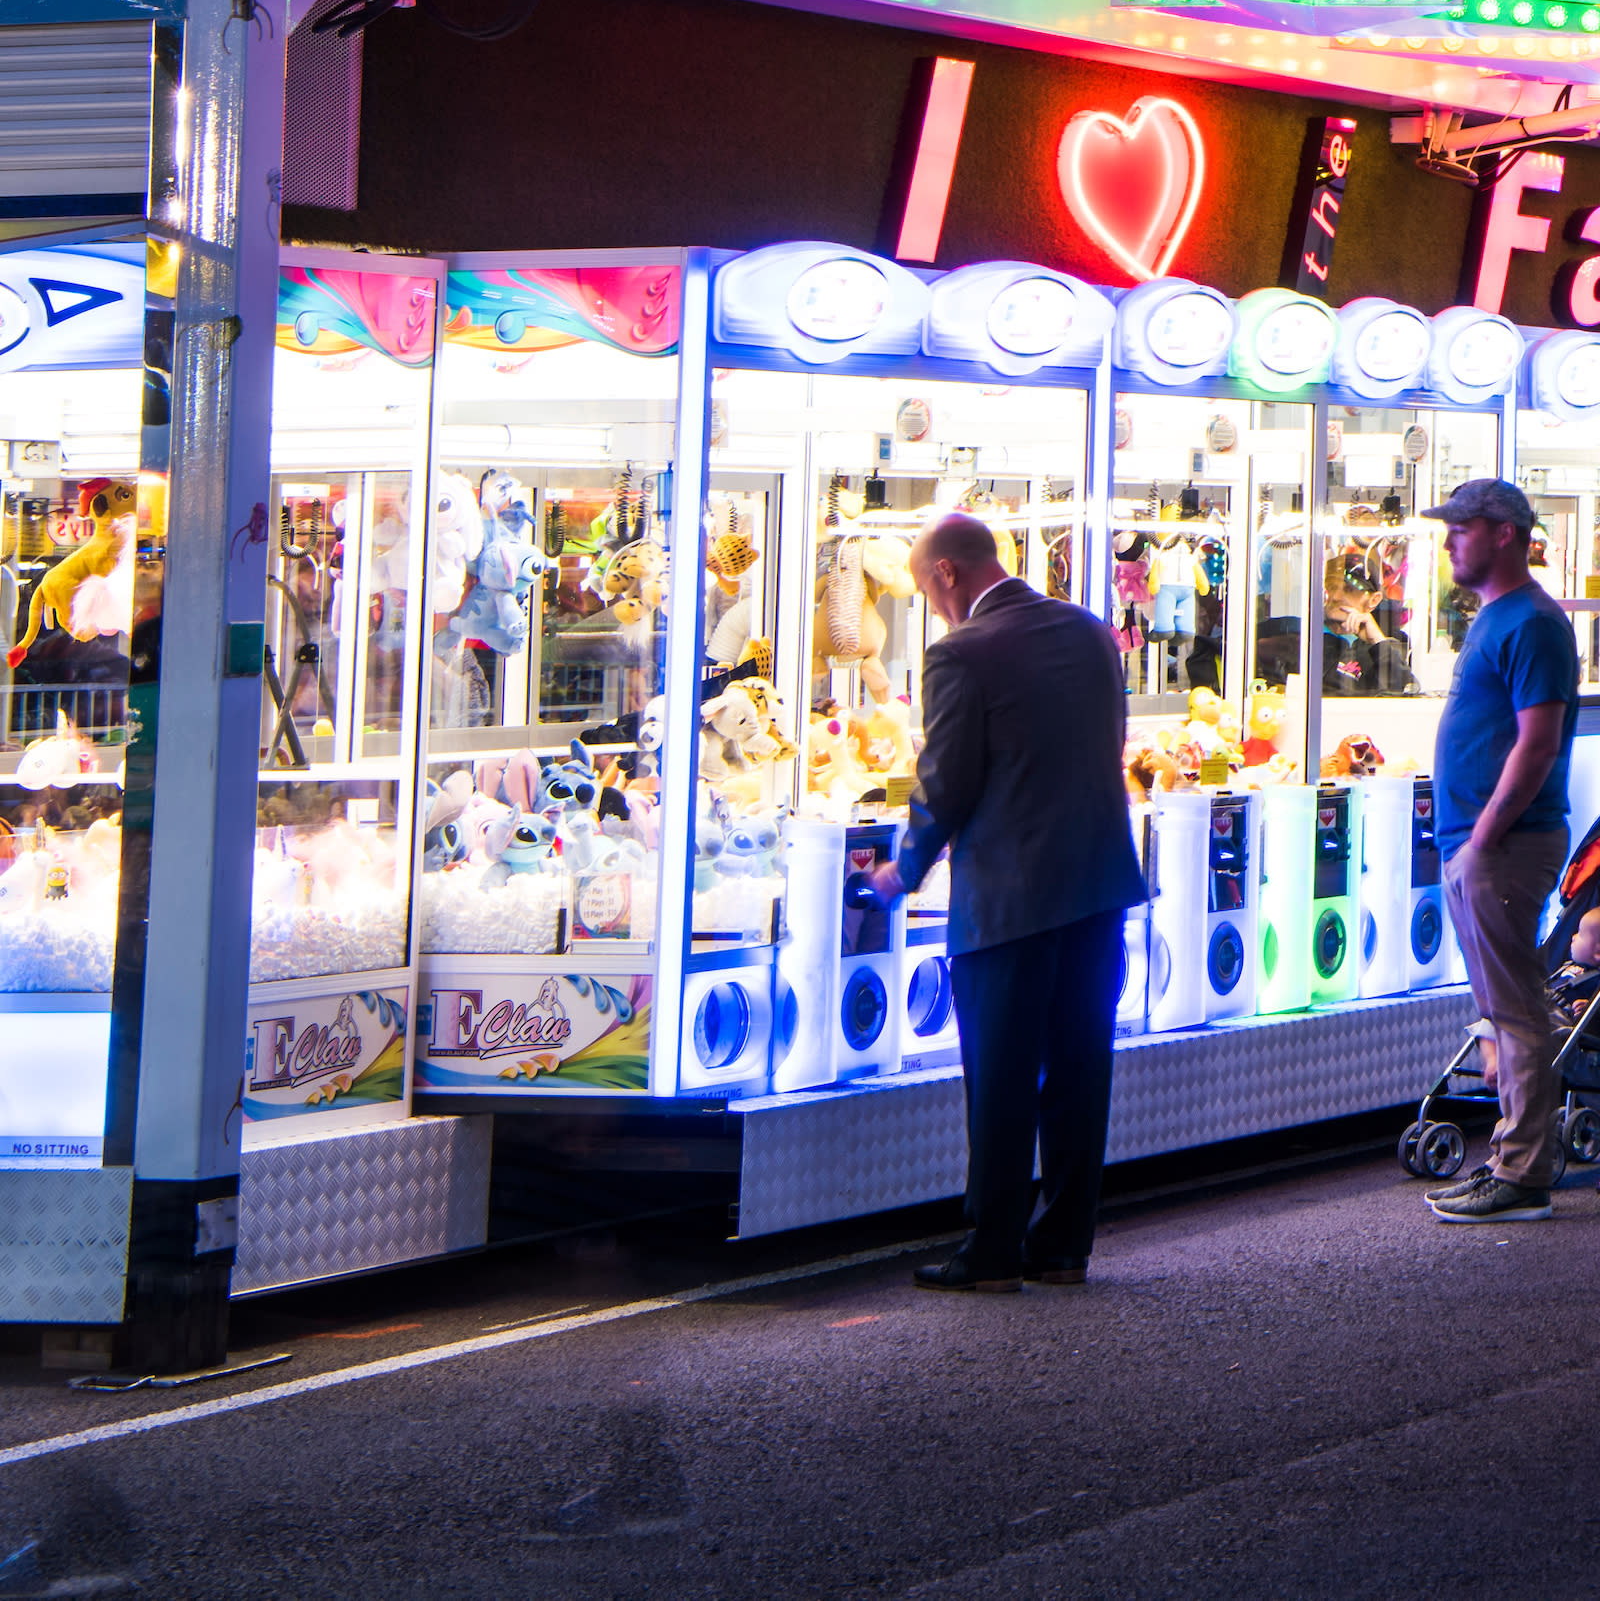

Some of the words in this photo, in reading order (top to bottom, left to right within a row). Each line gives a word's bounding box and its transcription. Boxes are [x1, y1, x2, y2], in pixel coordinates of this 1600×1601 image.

[896, 56, 976, 263] I
[1304, 134, 1348, 282] the
[13, 1143, 32, 1154] NO
[34, 1144, 89, 1155] SITTING
